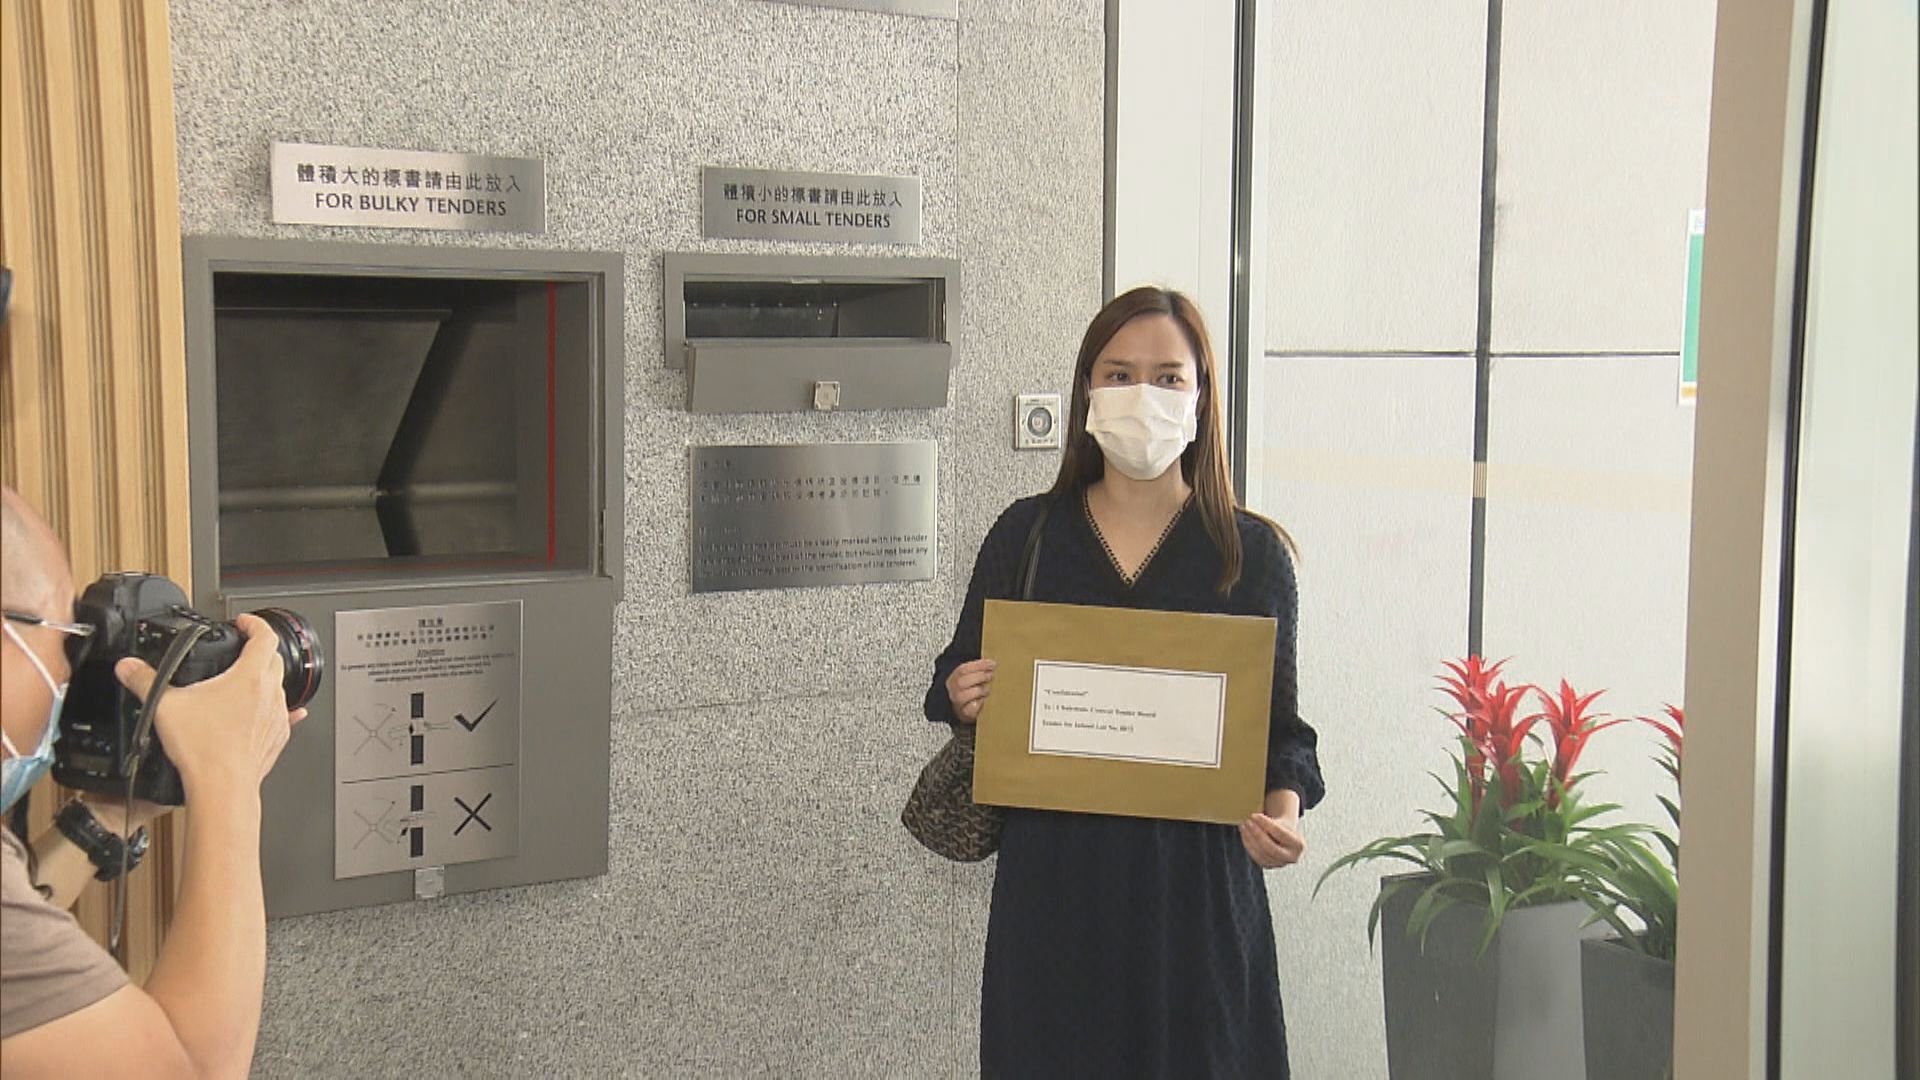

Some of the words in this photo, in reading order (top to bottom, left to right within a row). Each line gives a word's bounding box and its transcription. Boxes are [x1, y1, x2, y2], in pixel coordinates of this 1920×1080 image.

[297, 163, 521, 193] 體積大的標書請由此放入
[315, 193, 353, 209] FOR
[360, 194, 419, 213] BULKY
[425, 197, 507, 216] TENDERS
[723, 182, 903, 208] 體積小的標書請由此放入
[736, 208, 767, 224] FOR
[771, 209, 822, 227] SMALL
[825, 211, 891, 229] TENDERS
[841, 536, 869, 545] marked
[871, 535, 888, 544] with
[890, 534, 902, 543] the
[903, 534, 928, 542] tender
[845, 549, 858, 558] but
[859, 548, 883, 557] should
[884, 548, 897, 556] not
[915, 547, 928, 555] any
[873, 560, 884, 568] the
